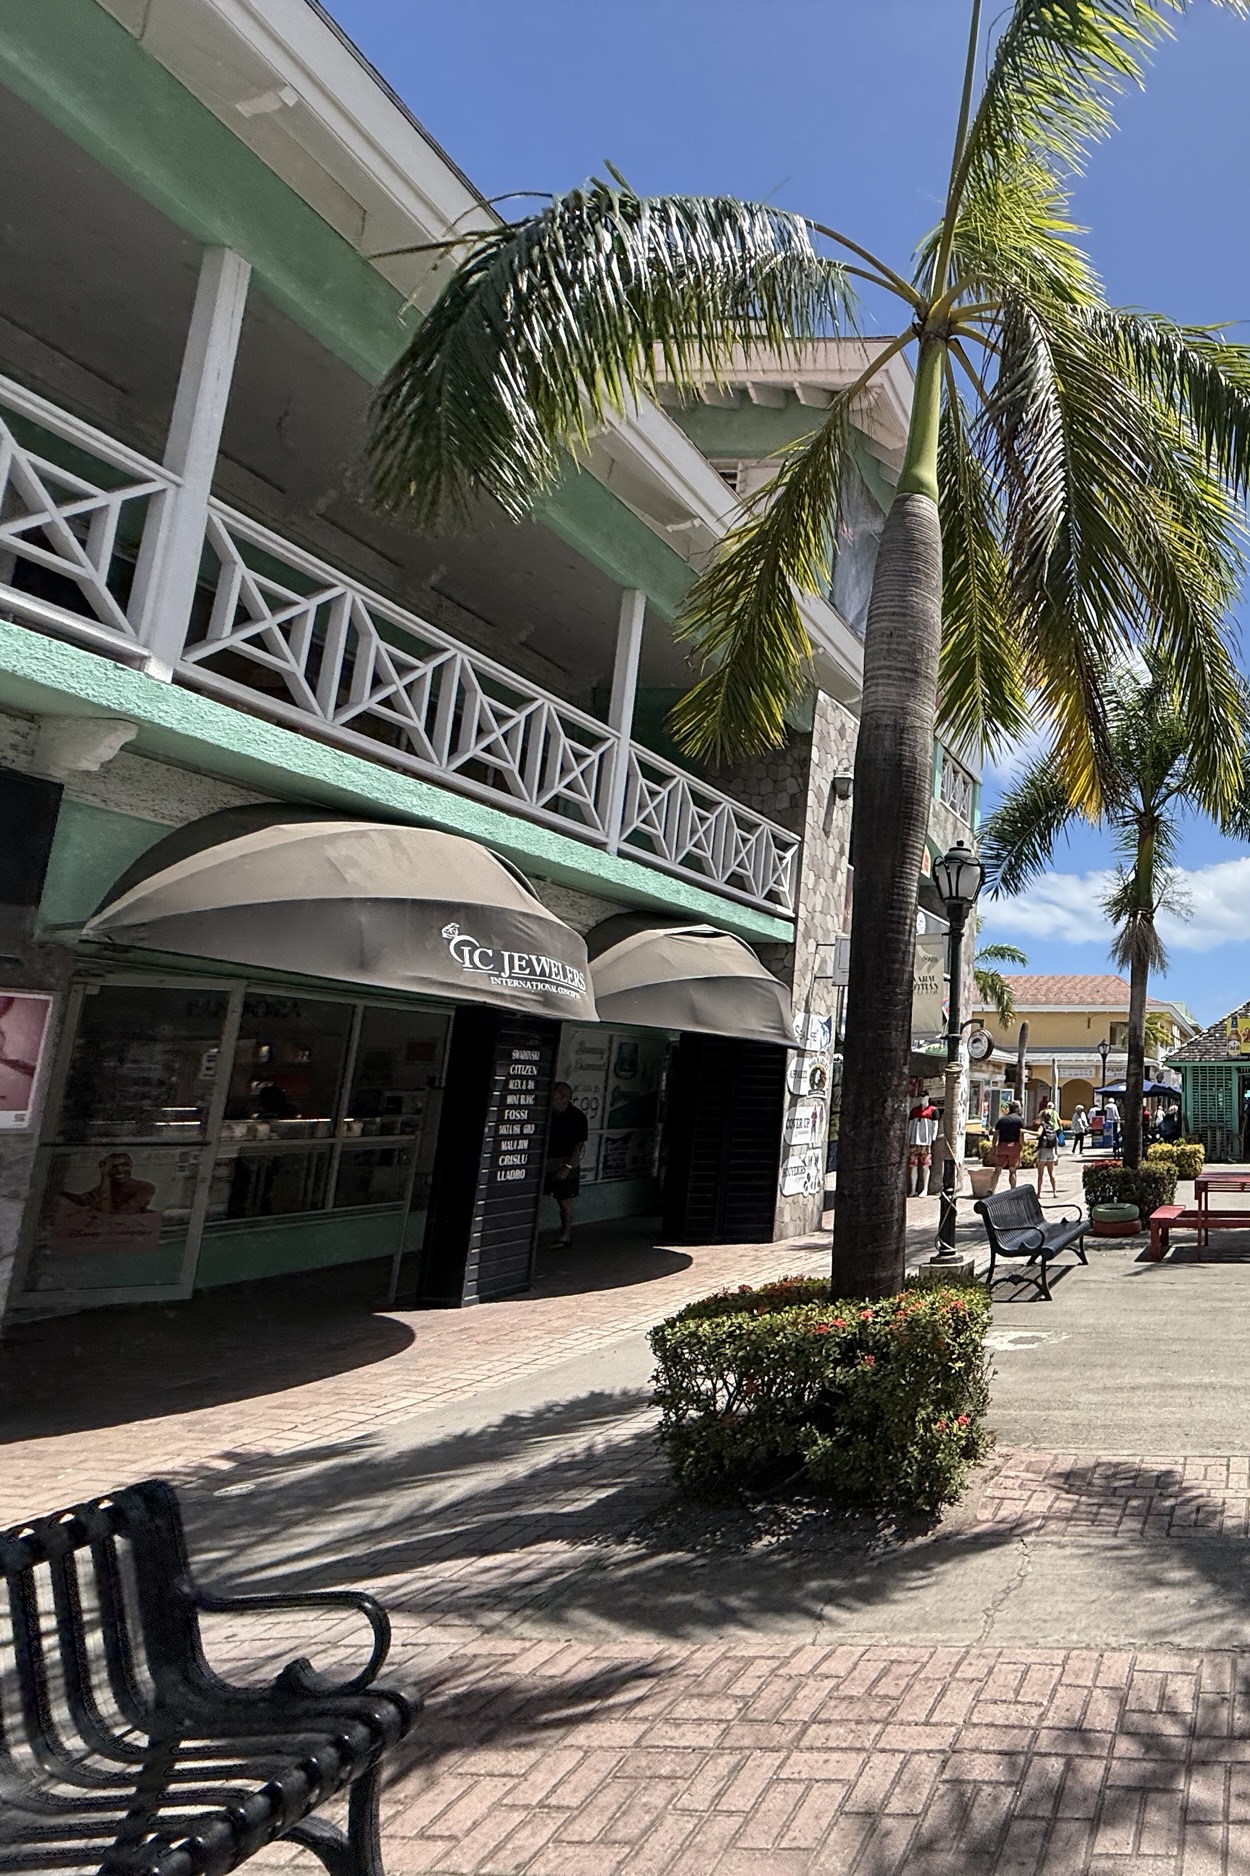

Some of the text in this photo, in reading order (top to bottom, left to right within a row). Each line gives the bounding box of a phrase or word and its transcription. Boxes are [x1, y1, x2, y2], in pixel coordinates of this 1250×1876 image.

[501, 950, 587, 992] JEWELERS
[490, 976, 557, 994] INTERNATIONAL
[510, 1064, 539, 1076] CITIZEN
[498, 1154, 529, 1166] CRISLU
[497, 1169, 526, 1182] LLADRO
